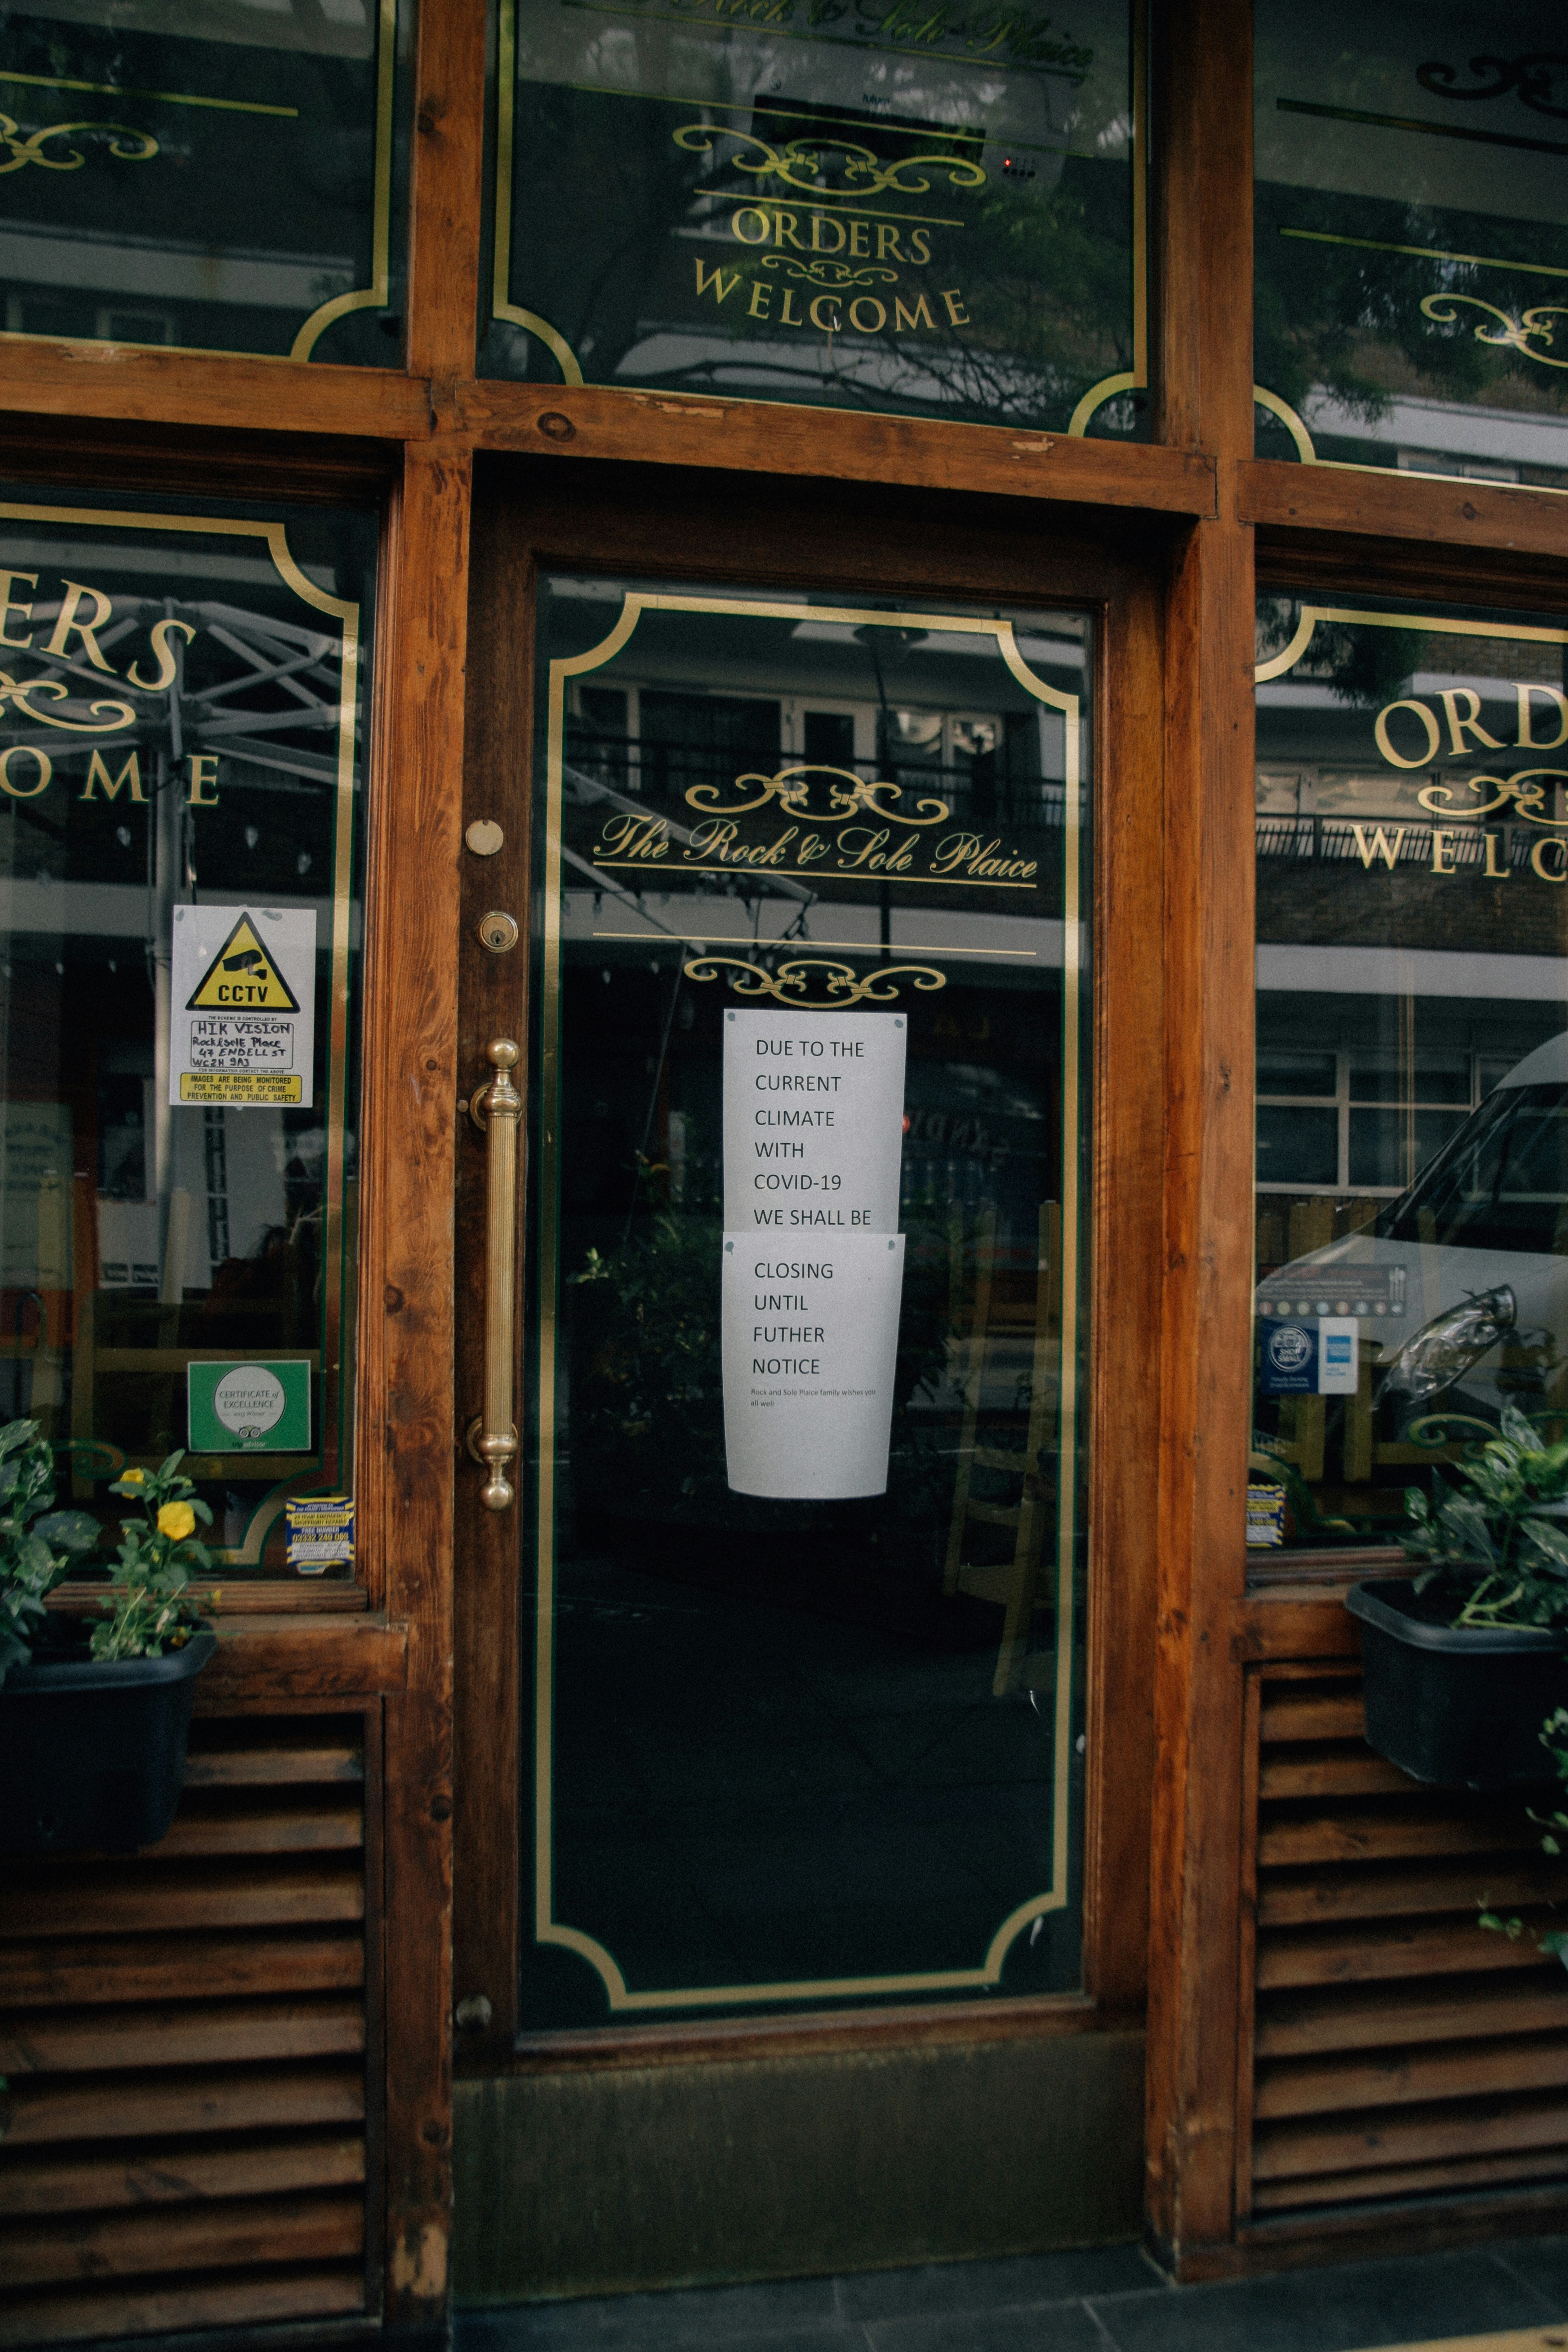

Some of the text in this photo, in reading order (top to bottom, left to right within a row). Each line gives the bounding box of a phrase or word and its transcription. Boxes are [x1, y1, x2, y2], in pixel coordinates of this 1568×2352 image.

[731, 207, 930, 265] ORDERS
[694, 258, 970, 333] WELCOME
[1374, 682, 1568, 768] ORD
[0, 746, 219, 805] OME
[593, 815, 1038, 878] The Rock & Sole Plaice
[1349, 824, 1568, 882] WELC
[218, 984, 268, 1002] CCTV
[198, 1022, 291, 1036] HIK VISION
[199, 1049, 214, 1058] 47
[218, 1048, 268, 1057] ENDELL
[756, 1040, 864, 1057] DUE TO THE
[755, 1075, 842, 1091] CURRENT
[755, 1110, 835, 1126] CLIMATE
[755, 1142, 804, 1158] WITH
[754, 1174, 842, 1190] COVID-19
[754, 1209, 871, 1225] WE SHALL BE
[755, 1263, 834, 1279] CLOSING
[755, 1295, 808, 1311] UNTIL
[753, 1327, 825, 1343] FUTHER
[752, 1359, 820, 1374] NOTICE
[220, 1390, 270, 1399] CERTIFICATE
[820, 1389, 840, 1397] family
[224, 1400, 275, 1409] EXCELLENCE
